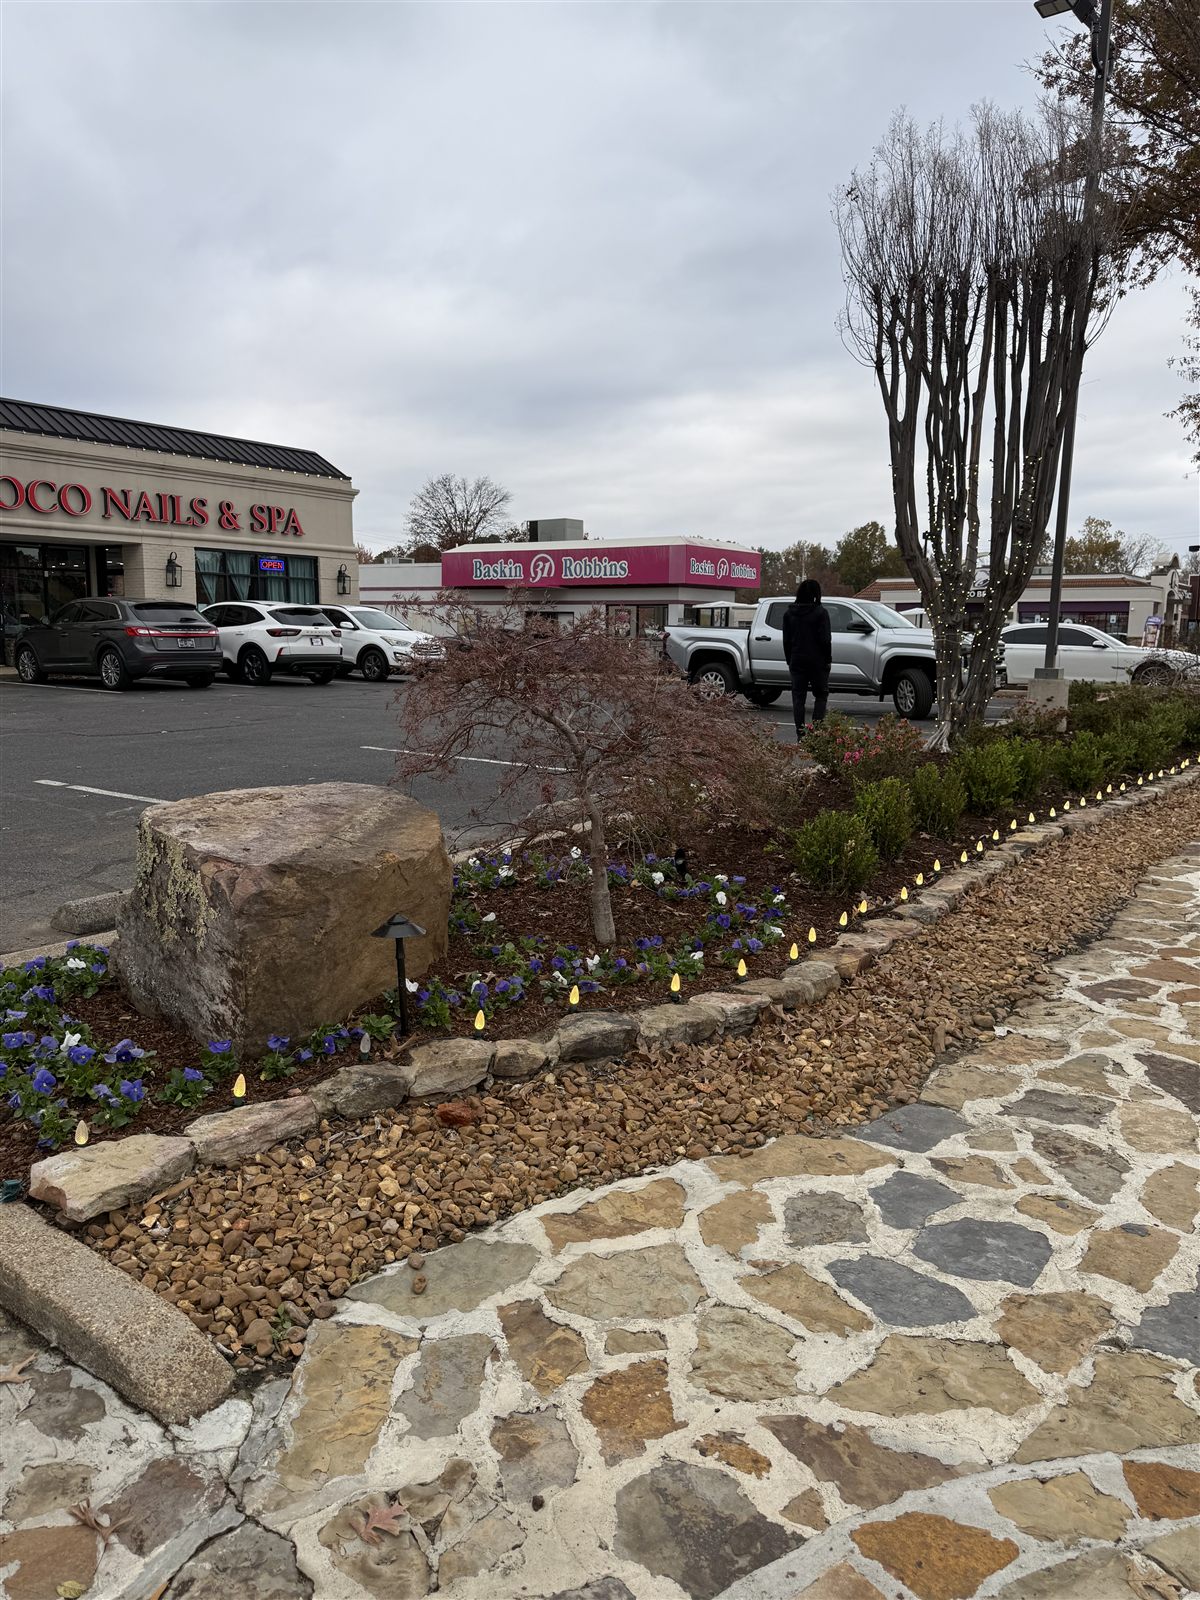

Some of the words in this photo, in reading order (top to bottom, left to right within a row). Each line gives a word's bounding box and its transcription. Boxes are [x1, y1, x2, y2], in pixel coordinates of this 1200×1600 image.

[0, 475, 92, 517] OCO
[101, 487, 209, 528] NAILS
[218, 500, 244, 530] &
[250, 503, 305, 536] SPA
[262, 561, 283, 569] OPEN
[473, 559, 524, 580] Baskin
[562, 556, 628, 578] Robbins
[690, 558, 715, 576] Baskin
[731, 562, 757, 579] Robbins
